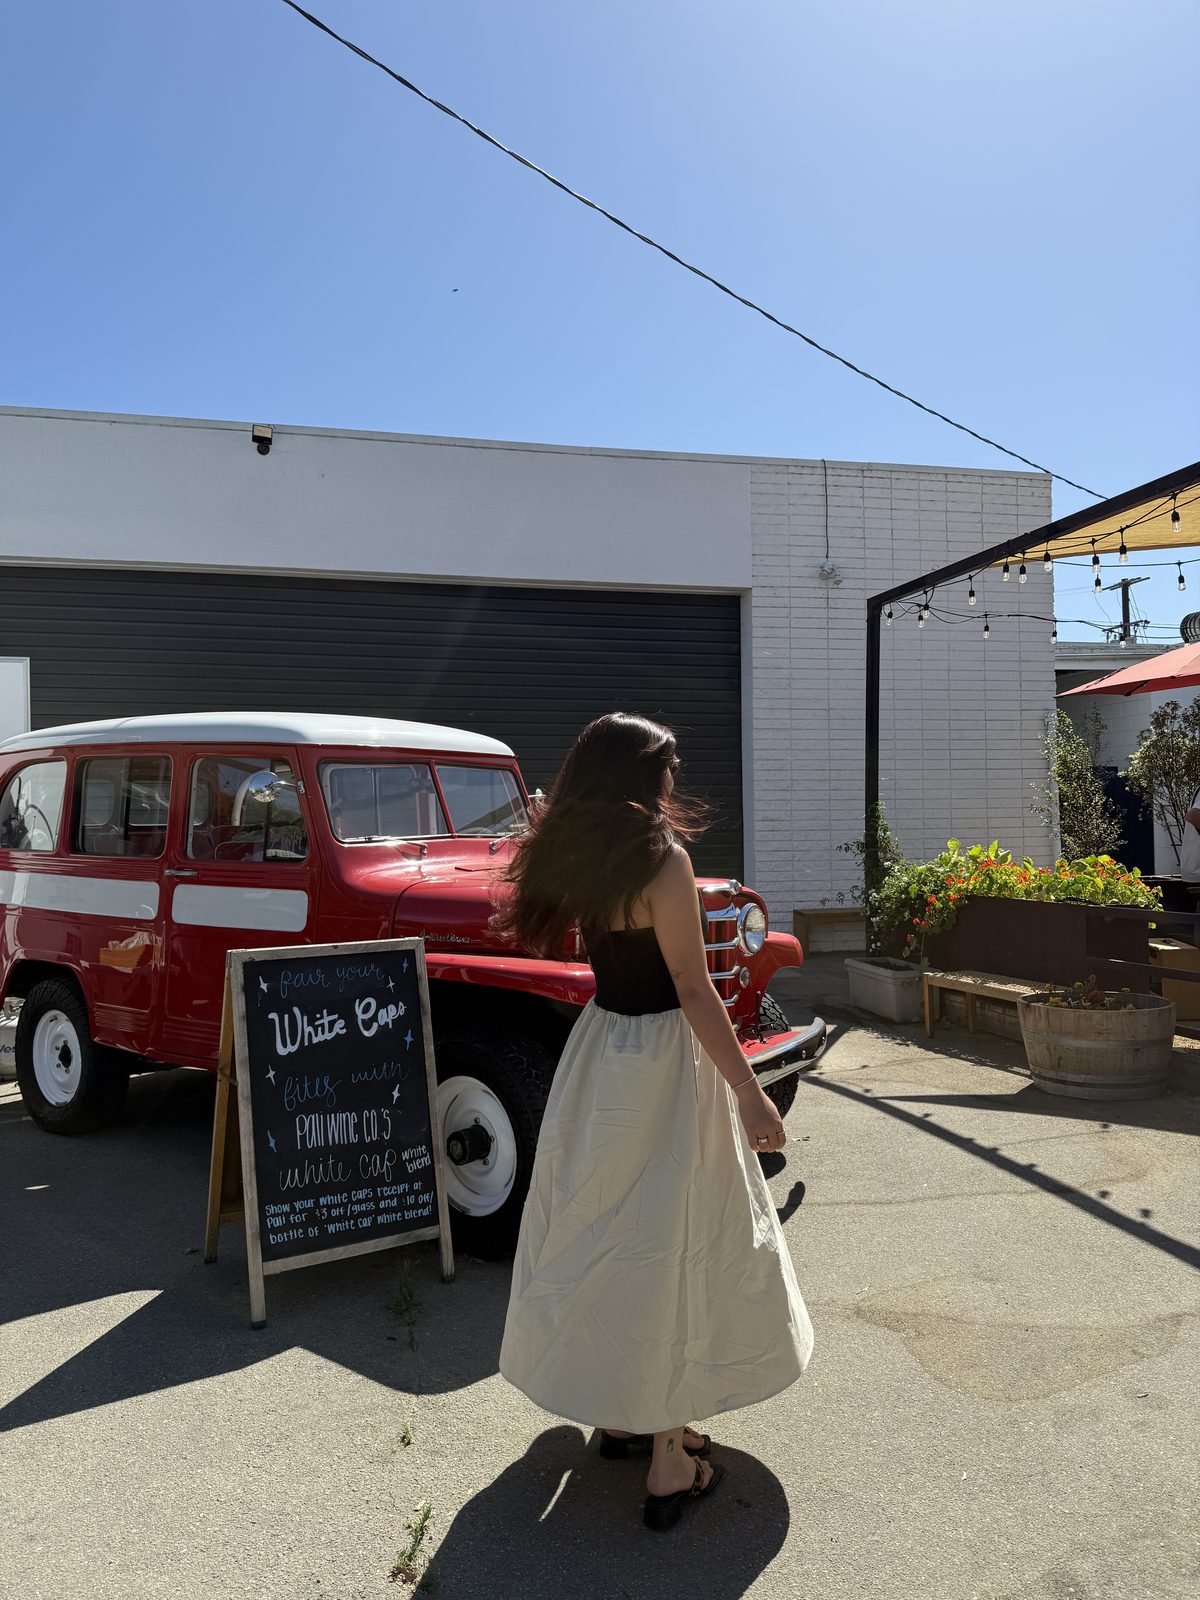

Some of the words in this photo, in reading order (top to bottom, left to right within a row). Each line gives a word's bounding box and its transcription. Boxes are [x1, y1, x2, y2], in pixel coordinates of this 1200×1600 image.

[280, 970, 330, 998] pair
[336, 963, 386, 992] your
[268, 1006, 347, 1056] White
[355, 997, 407, 1038] Caps
[351, 1061, 409, 1084] with
[279, 1154, 351, 1191] white
[359, 1149, 397, 1183] cap
[401, 1144, 428, 1162] white
[405, 1152, 432, 1173] blend
[265, 1203, 290, 1216] Show
[293, 1199, 315, 1212] your
[319, 1192, 348, 1206] white
[413, 1180, 423, 1191] at
[289, 1212, 308, 1224] for
[379, 1197, 398, 1209] and
[269, 1228, 304, 1245] bottle
[307, 1226, 320, 1238] of
[377, 1212, 403, 1225] white
[404, 1204, 432, 1220] blend!
